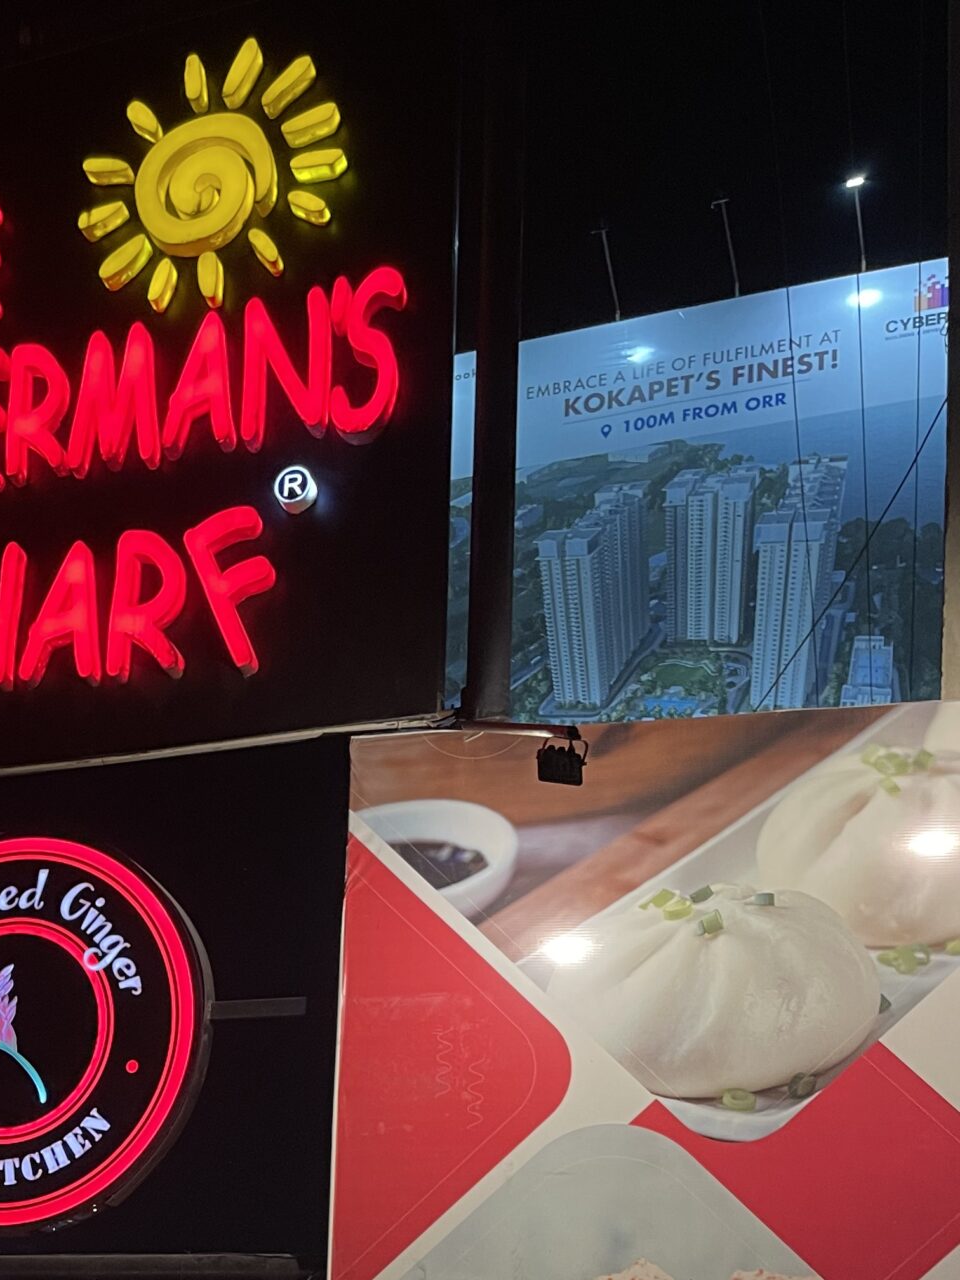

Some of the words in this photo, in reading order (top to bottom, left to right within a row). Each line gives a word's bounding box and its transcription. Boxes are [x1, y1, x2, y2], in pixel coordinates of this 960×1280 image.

[526, 373, 607, 400] EMBRACE
[613, 371, 626, 385] A
[632, 361, 666, 380] LIFE
[671, 355, 696, 372] OF
[703, 334, 813, 367] FULFILMENT
[819, 329, 841, 346] AT
[563, 369, 721, 417] KOKAPET'S
[732, 349, 838, 386] FINEST!
[624, 411, 675, 433] 100M
[682, 401, 738, 422] FROM
[745, 392, 787, 411] ORR
[60, 881, 142, 996] Ginger
